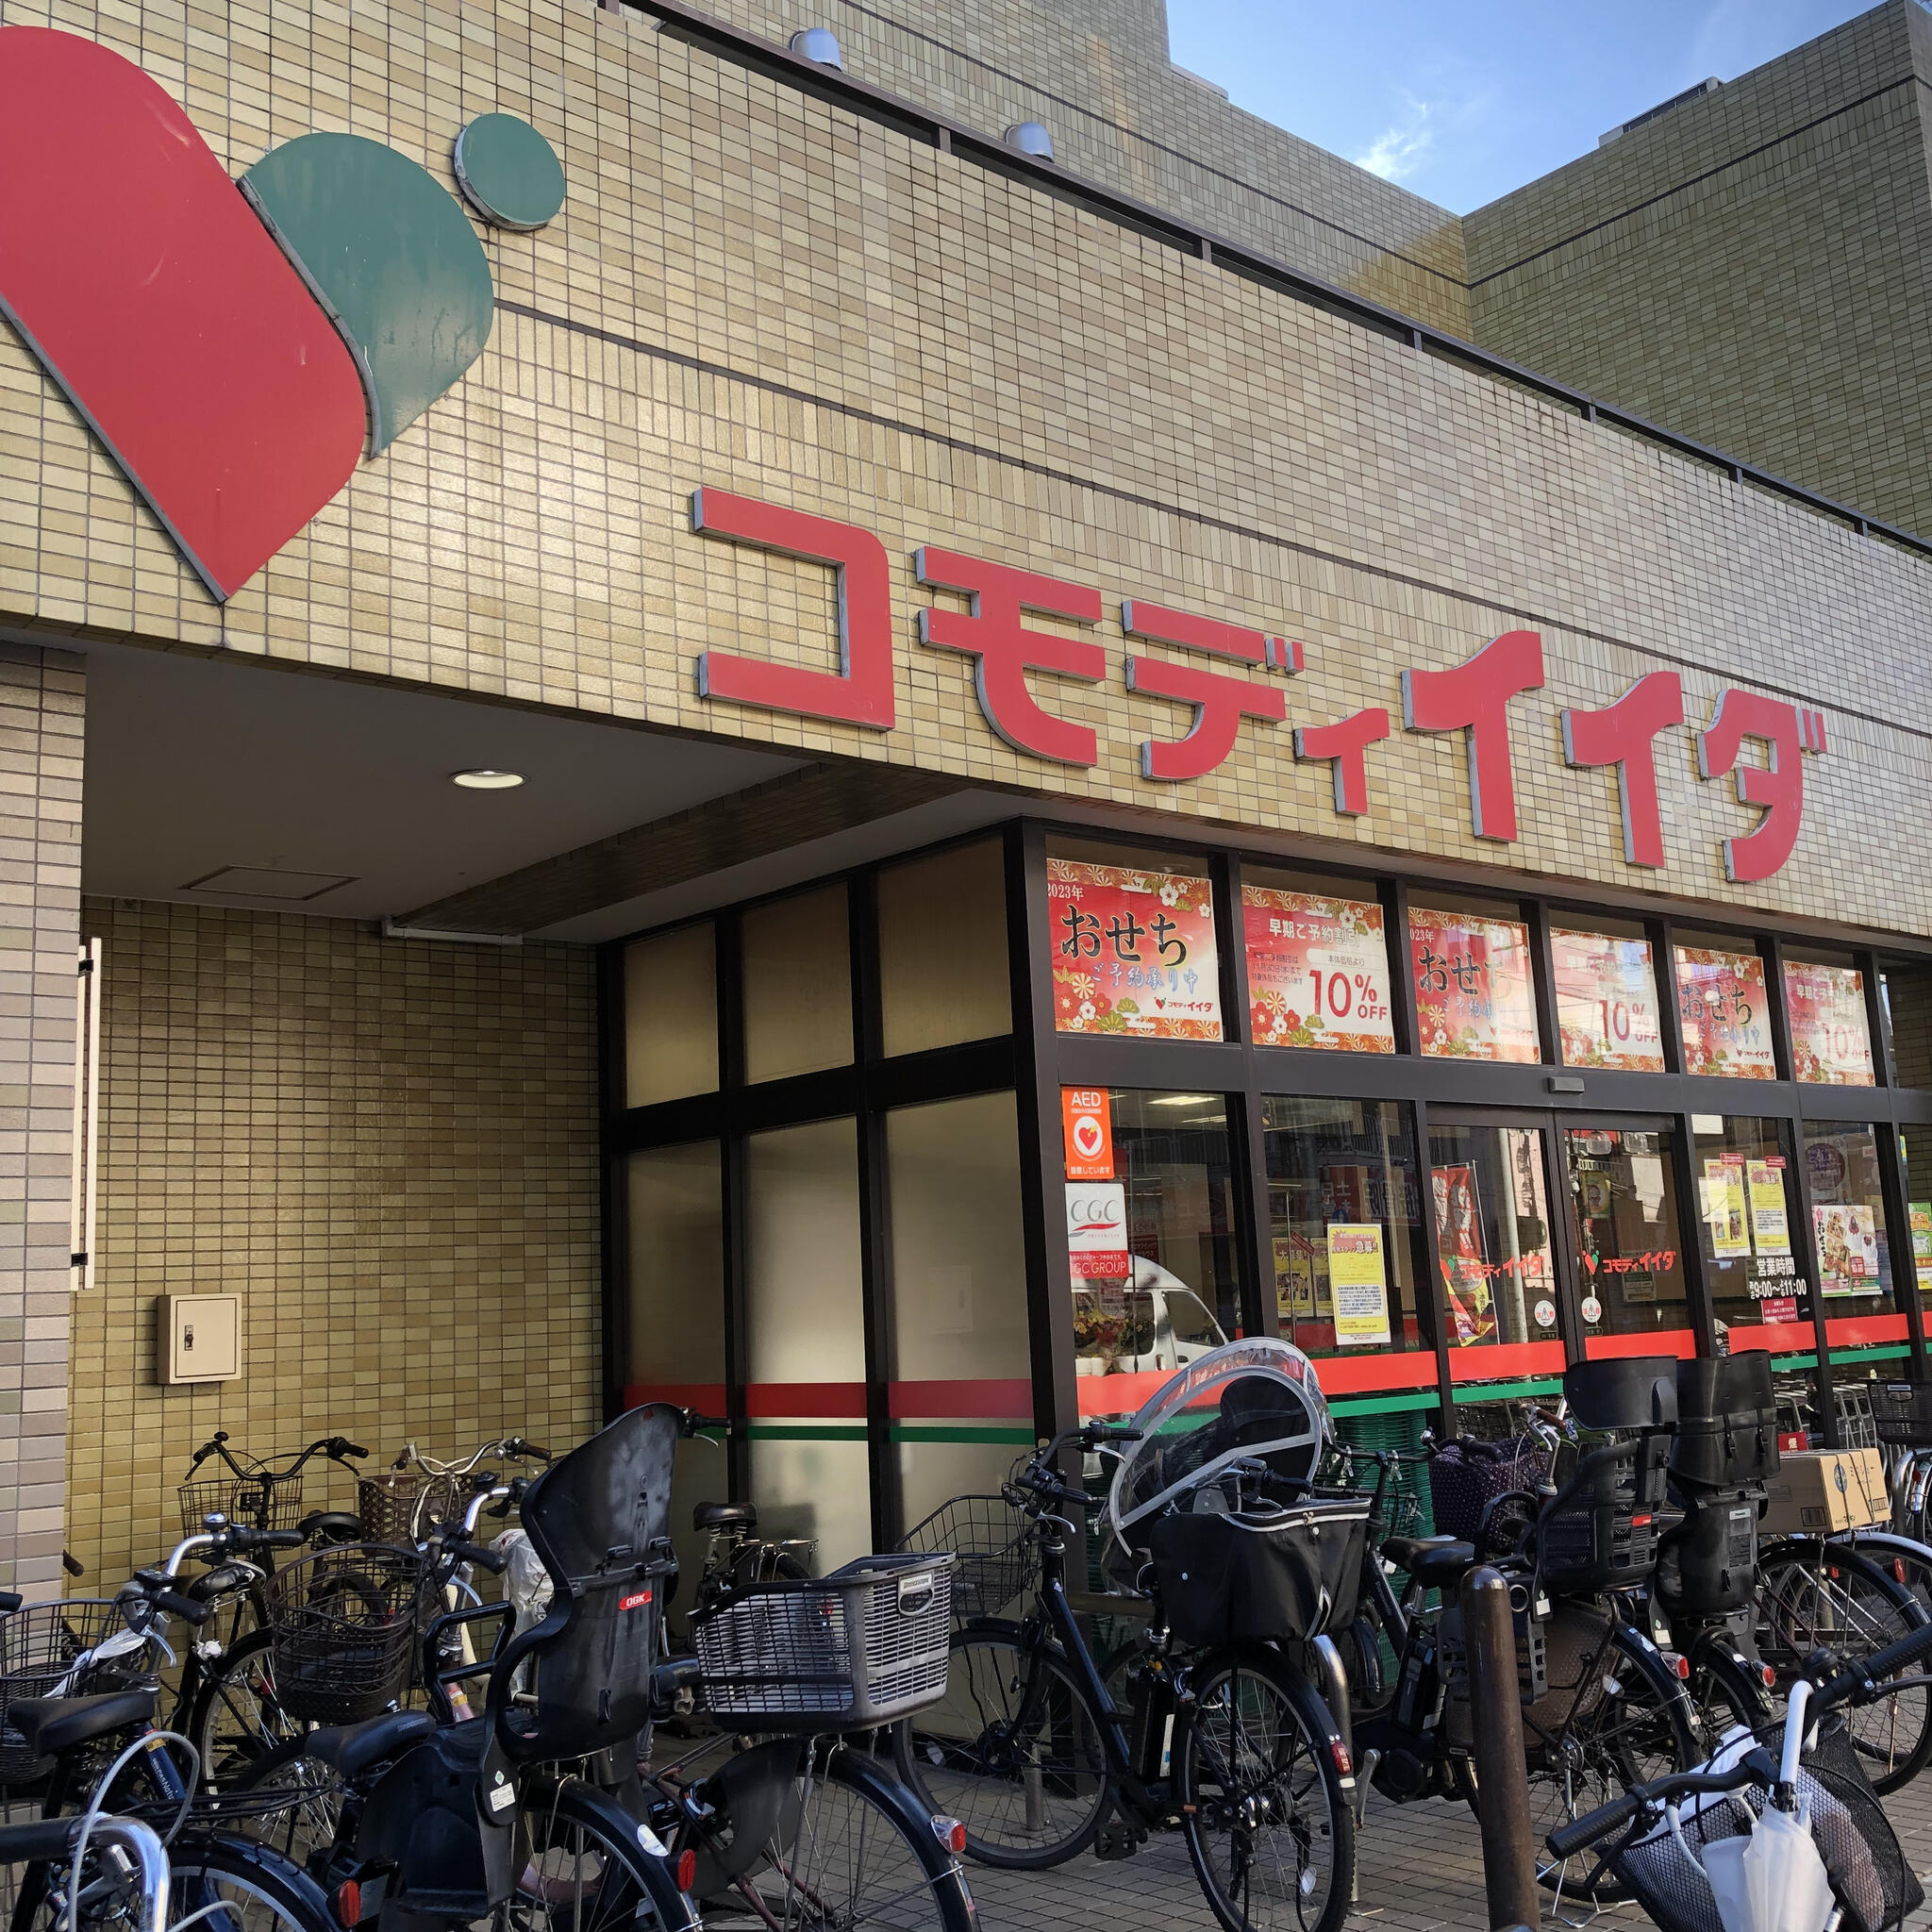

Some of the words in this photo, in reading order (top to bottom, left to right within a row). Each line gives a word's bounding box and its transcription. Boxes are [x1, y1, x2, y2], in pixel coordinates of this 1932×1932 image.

[692, 486, 1826, 884] コモディイイダ
[1061, 904, 1188, 967] おせち
[1269, 918, 1360, 948] 早期ご予約割引
[1092, 962, 1198, 994] ご予約承り中
[1357, 1005, 1387, 1021] OFF
[1071, 1091, 1102, 1108] AED
[1071, 1199, 1120, 1223] CGC
[1091, 1261, 1126, 1274] GROUP
[1459, 1256, 1544, 1279] コモディイイダ
[1602, 1250, 1676, 1274] コモディイイダ
[1756, 1257, 1796, 1277] 営業時間
[625, 1593, 645, 1607] OGK
